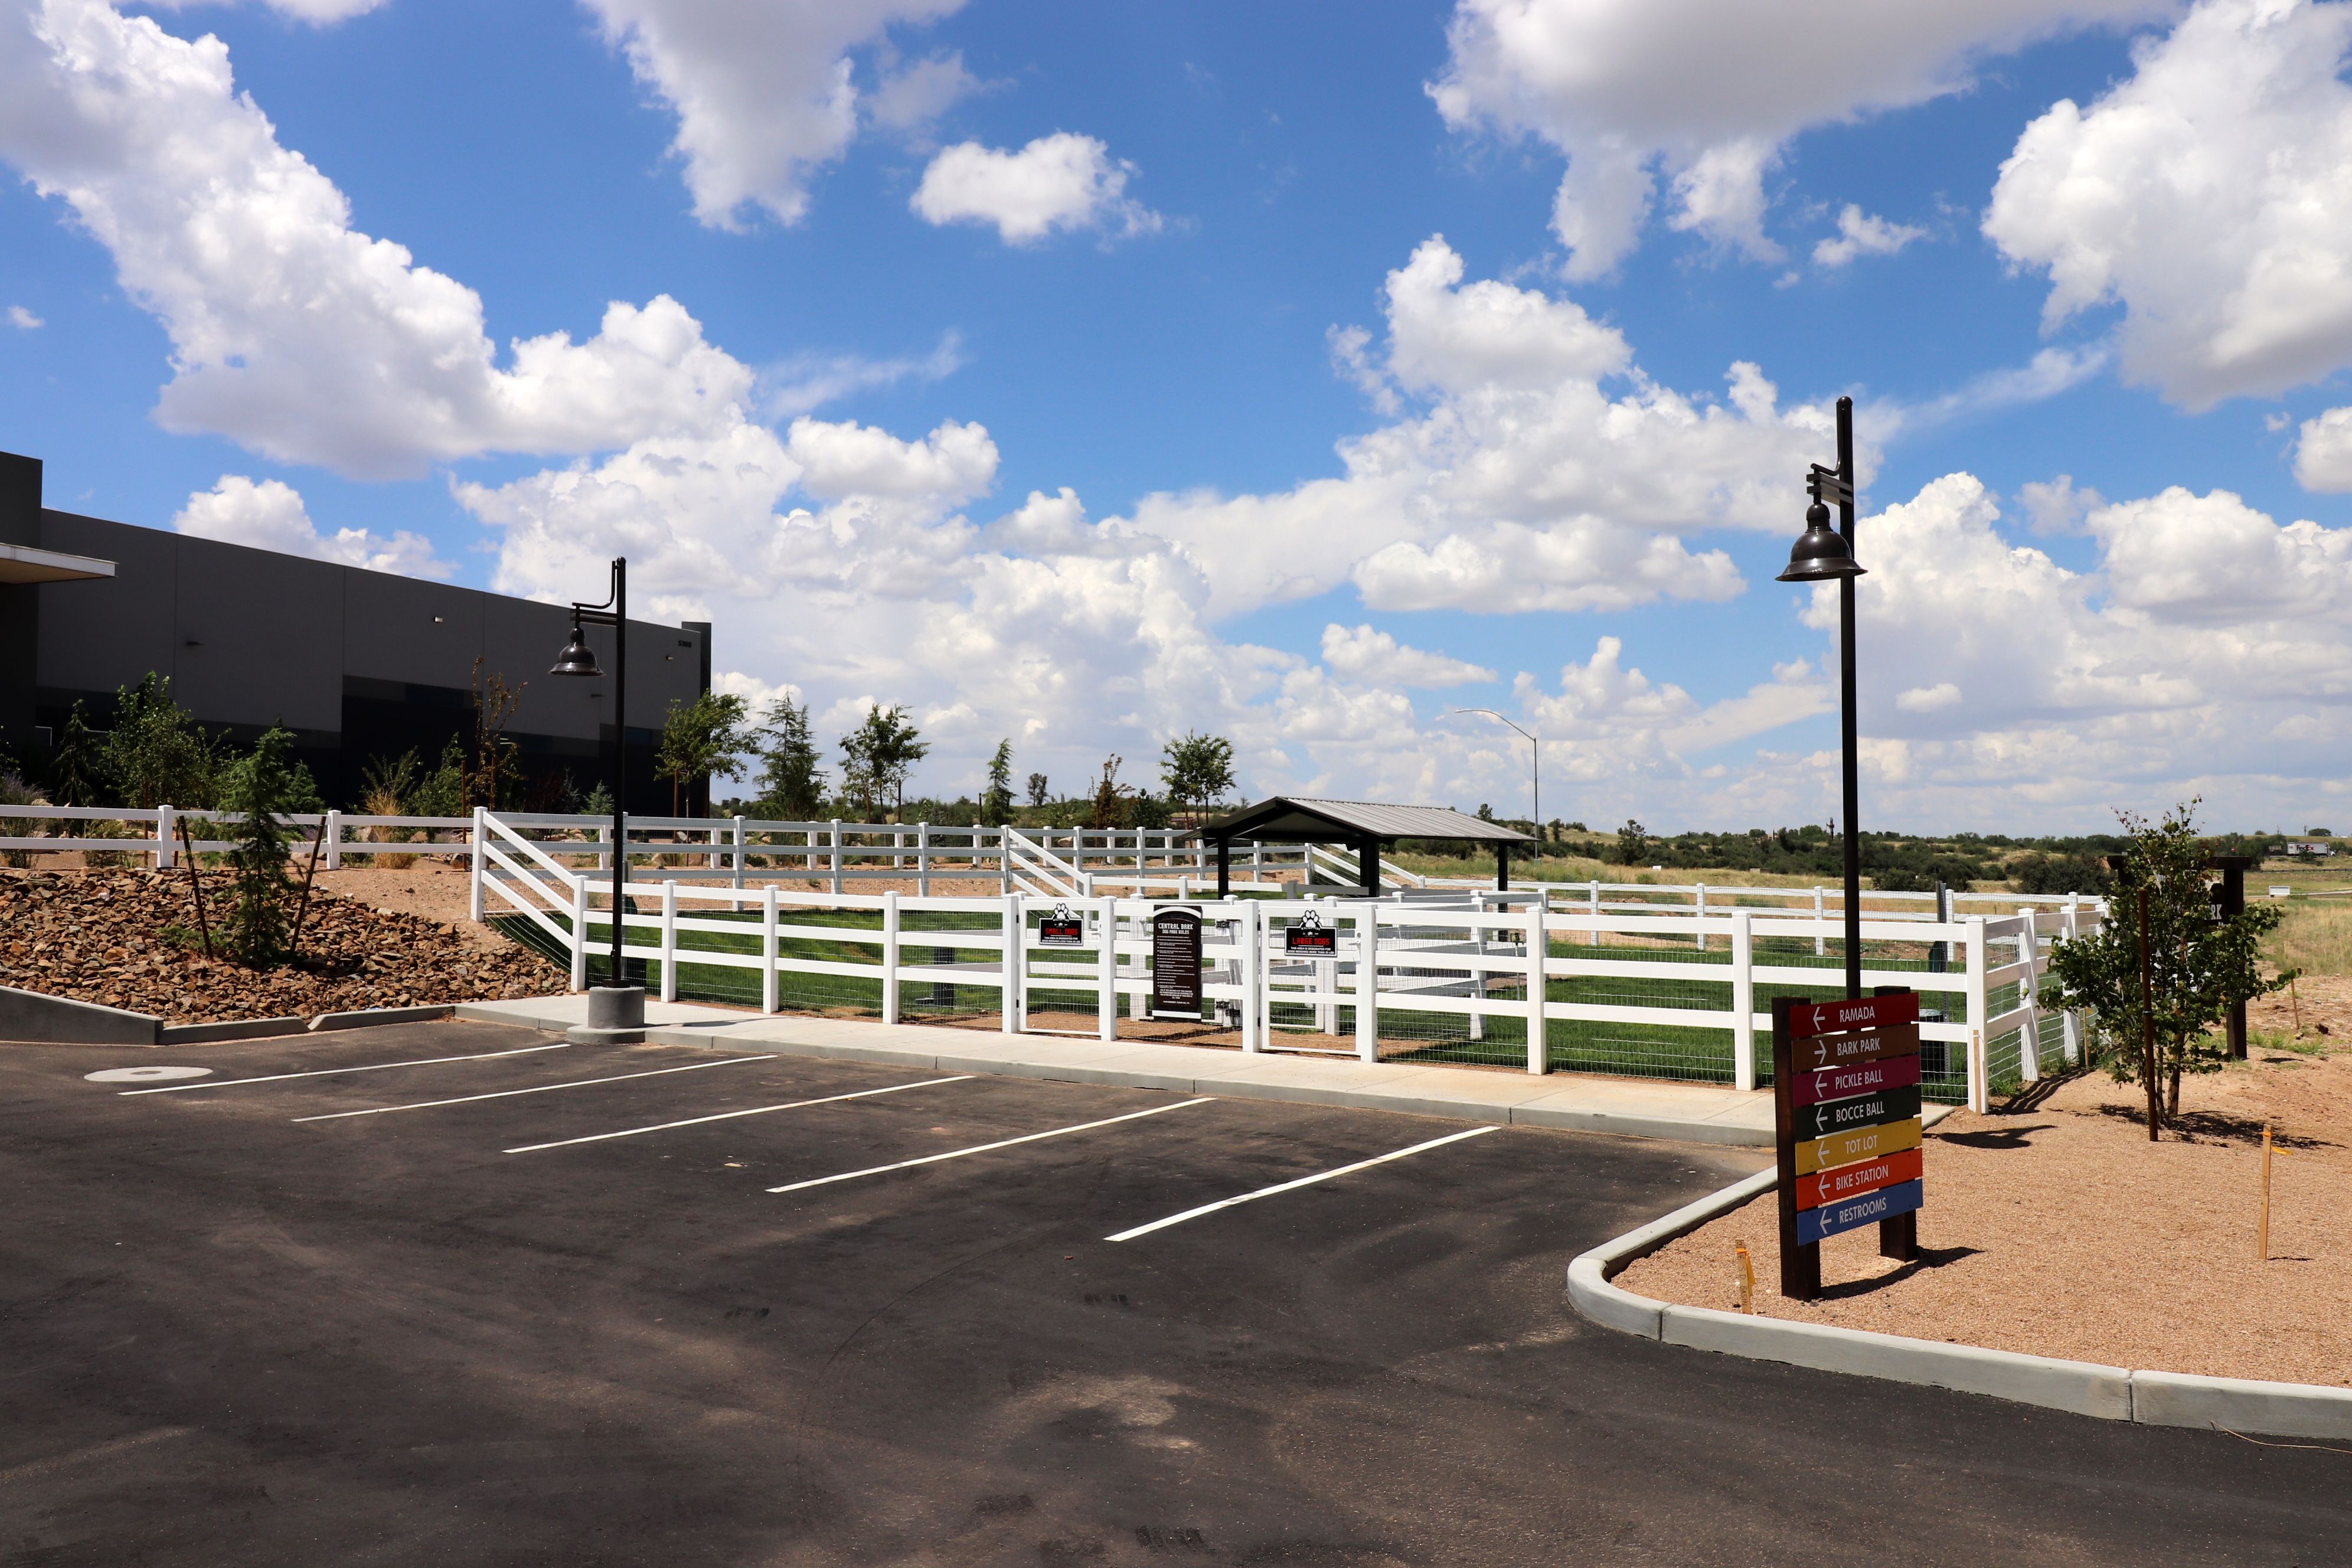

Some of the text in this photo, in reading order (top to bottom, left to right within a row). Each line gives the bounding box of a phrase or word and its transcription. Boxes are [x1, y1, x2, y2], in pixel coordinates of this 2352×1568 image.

[1840, 1005, 1876, 1023] RAMADA
[1837, 1037, 1880, 1056] BARK PARK
[1835, 1069, 1883, 1090] PICKLE BALL
[1836, 1100, 1884, 1123] BOCCE BALL
[1845, 1135, 1878, 1154] TOT LOT
[1836, 1164, 1889, 1191] BIKE STATION
[1839, 1197, 1887, 1224] RESTROOMS
